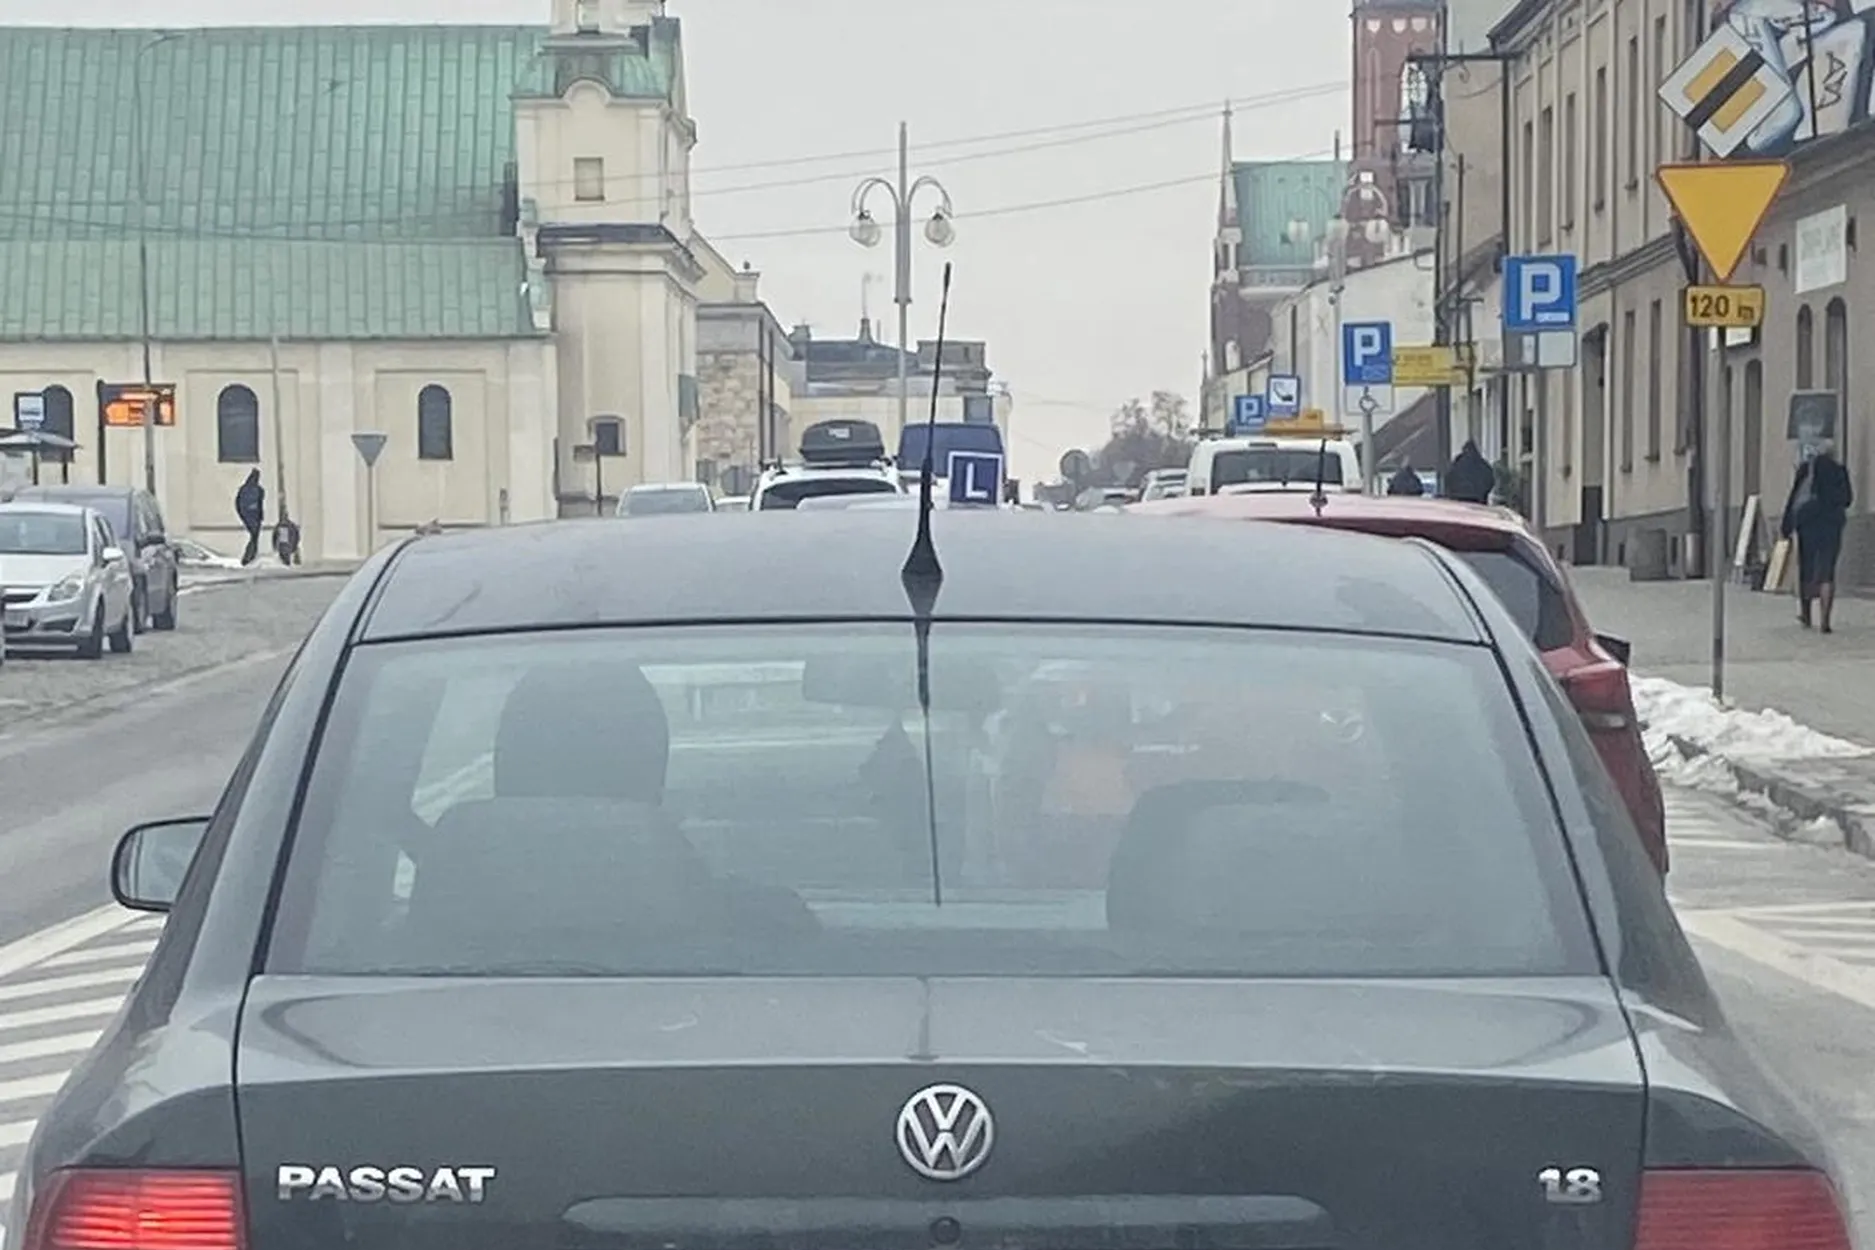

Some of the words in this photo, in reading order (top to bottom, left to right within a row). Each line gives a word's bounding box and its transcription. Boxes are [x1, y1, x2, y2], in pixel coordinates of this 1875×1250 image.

[1520, 263, 1561, 320] P
[1691, 294, 1730, 318] 120
[1353, 327, 1381, 366] P
[1240, 400, 1263, 424] P
[966, 462, 988, 498] L
[278, 1165, 495, 1202] PASSAT
